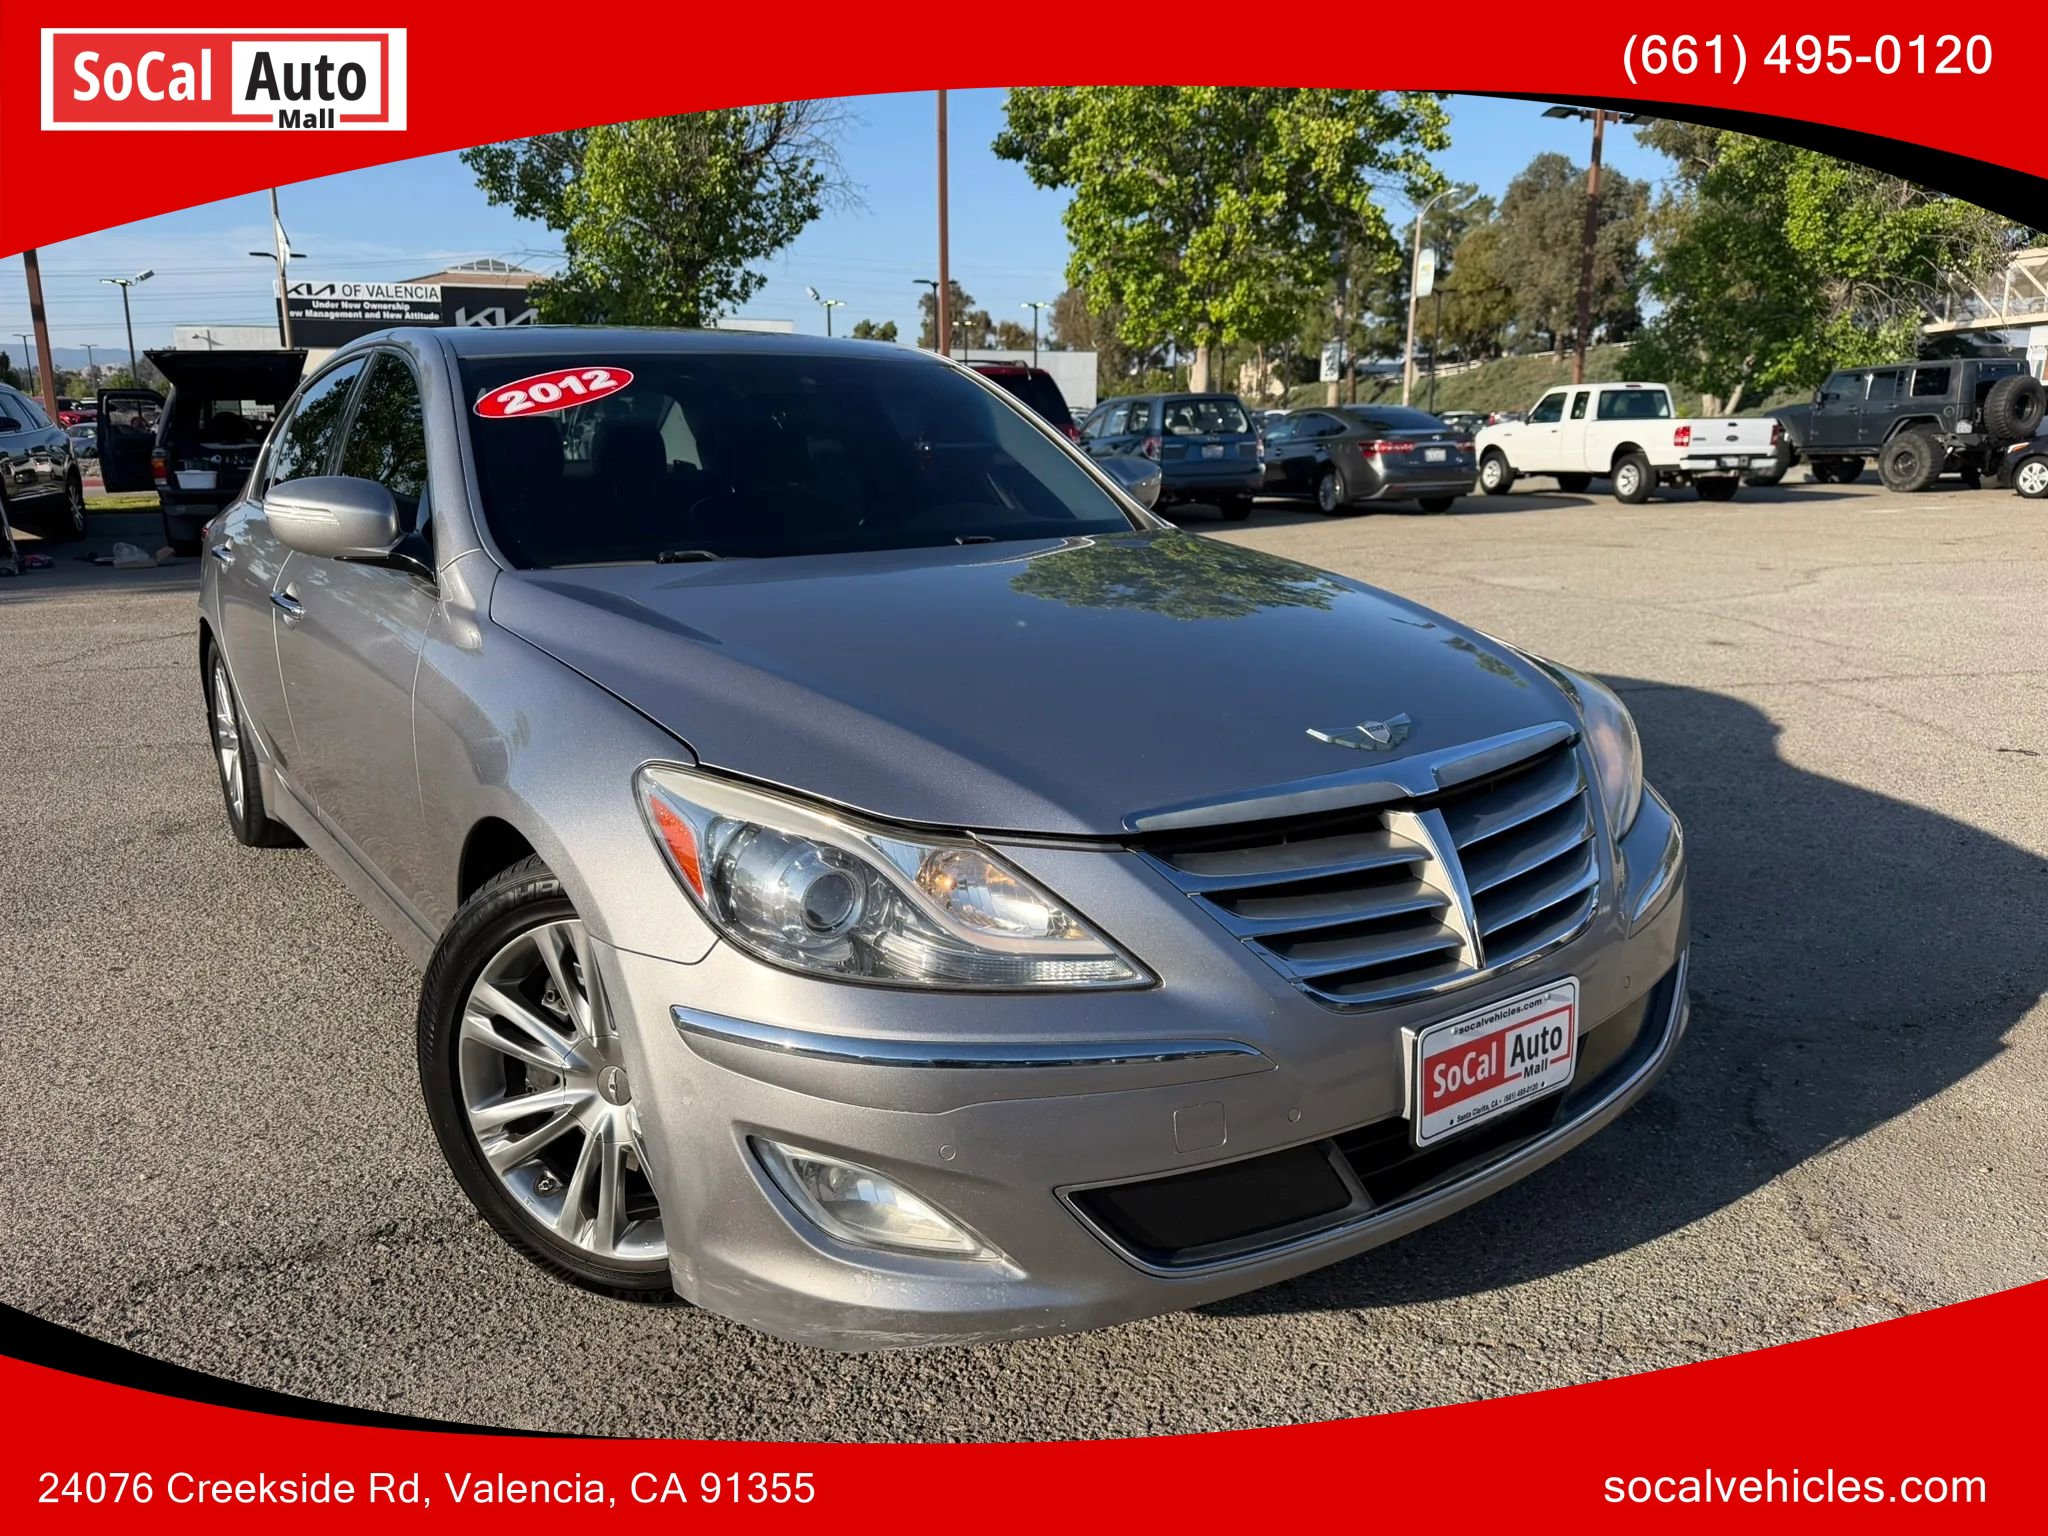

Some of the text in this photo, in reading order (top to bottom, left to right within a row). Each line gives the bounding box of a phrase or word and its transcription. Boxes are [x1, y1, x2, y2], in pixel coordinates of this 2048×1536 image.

[287, 283, 439, 300] KIA OF VALENCIA
[304, 309, 362, 320] Management
[364, 310, 381, 319] and
[383, 311, 402, 319] New
[404, 311, 440, 320] Attitude
[312, 301, 410, 311] Under New Ownership
[497, 369, 618, 414] 2012
[1458, 998, 1543, 1035] socalvehicles.com
[1432, 1025, 1563, 1099] SoCal Auto
[1523, 1058, 1549, 1079] Mall
